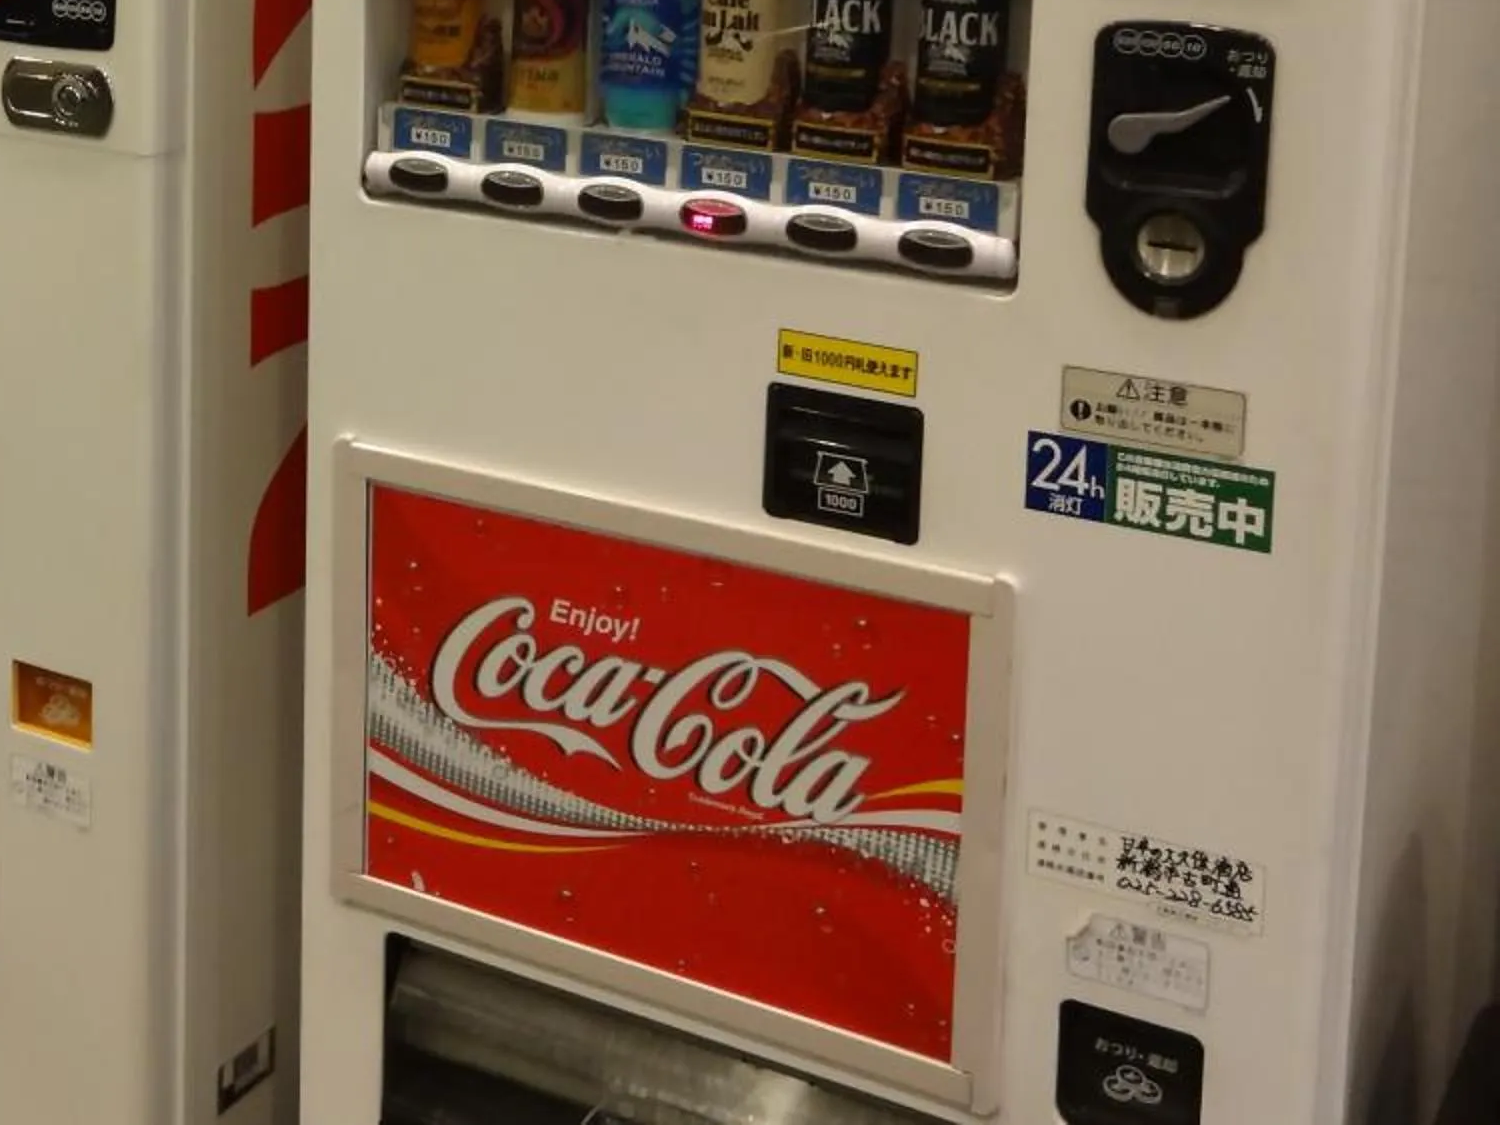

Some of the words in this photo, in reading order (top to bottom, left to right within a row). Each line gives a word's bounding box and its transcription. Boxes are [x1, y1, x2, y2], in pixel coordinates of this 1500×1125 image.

[414, 129, 448, 146] ¥150
[705, 170, 744, 187] ¥150
[812, 185, 853, 202] ¥150
[923, 200, 965, 216] ¥150
[1143, 386, 1188, 407] 注意
[824, 493, 858, 511] 1000
[1048, 493, 1083, 516] 消灯
[1113, 477, 1266, 545] 販売中
[549, 597, 641, 646] Enjoy!
[431, 594, 910, 824] Coca-Cola
